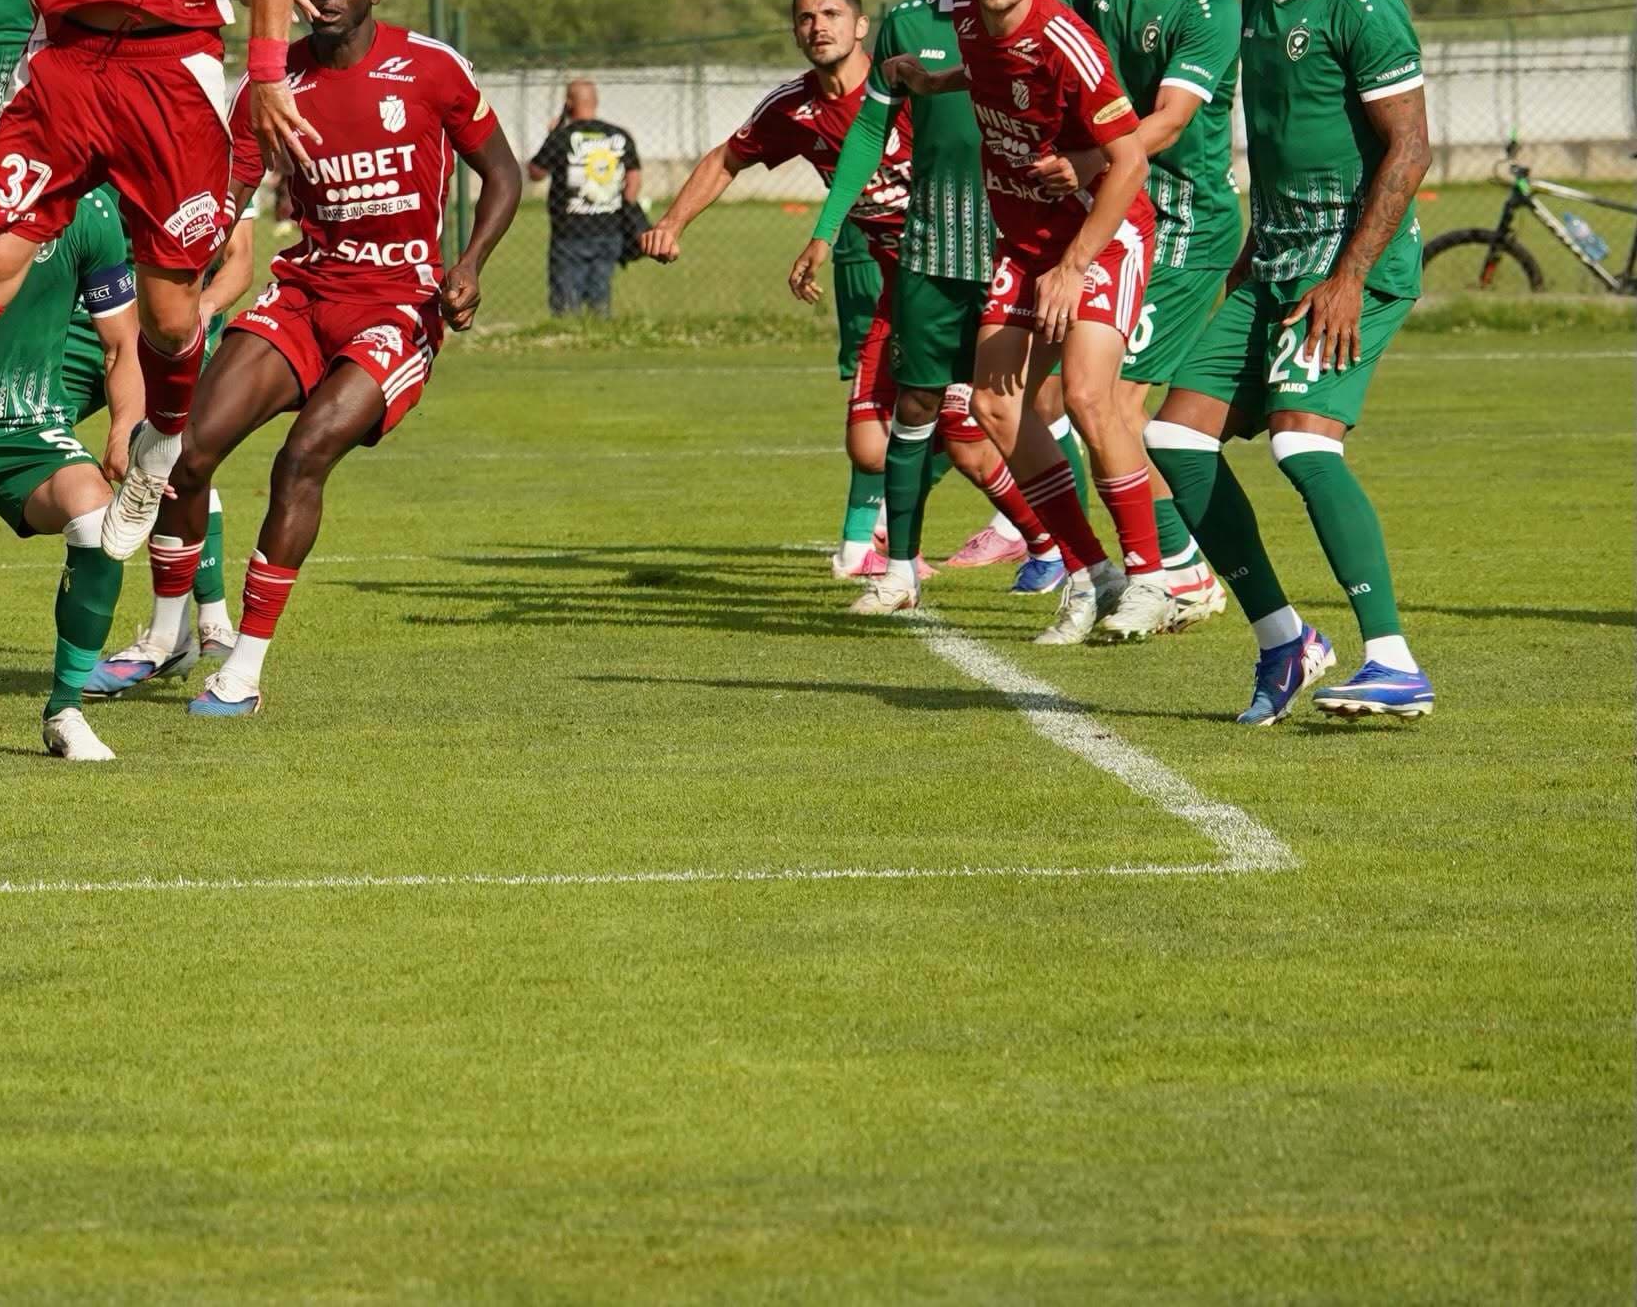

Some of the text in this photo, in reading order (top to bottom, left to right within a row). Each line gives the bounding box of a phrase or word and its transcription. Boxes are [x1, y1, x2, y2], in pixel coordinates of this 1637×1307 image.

[919, 48, 946, 60] JAKO
[975, 103, 1042, 141] NIBET
[368, 202, 395, 214] SPRE
[991, 256, 1014, 296] 6
[246, 311, 279, 331] Vestra
[1267, 327, 1321, 383] 24
[1279, 382, 1309, 394] JAKO
[39, 428, 84, 451] 5
[866, 495, 882, 505] JA
[200, 556, 216, 569] KO
